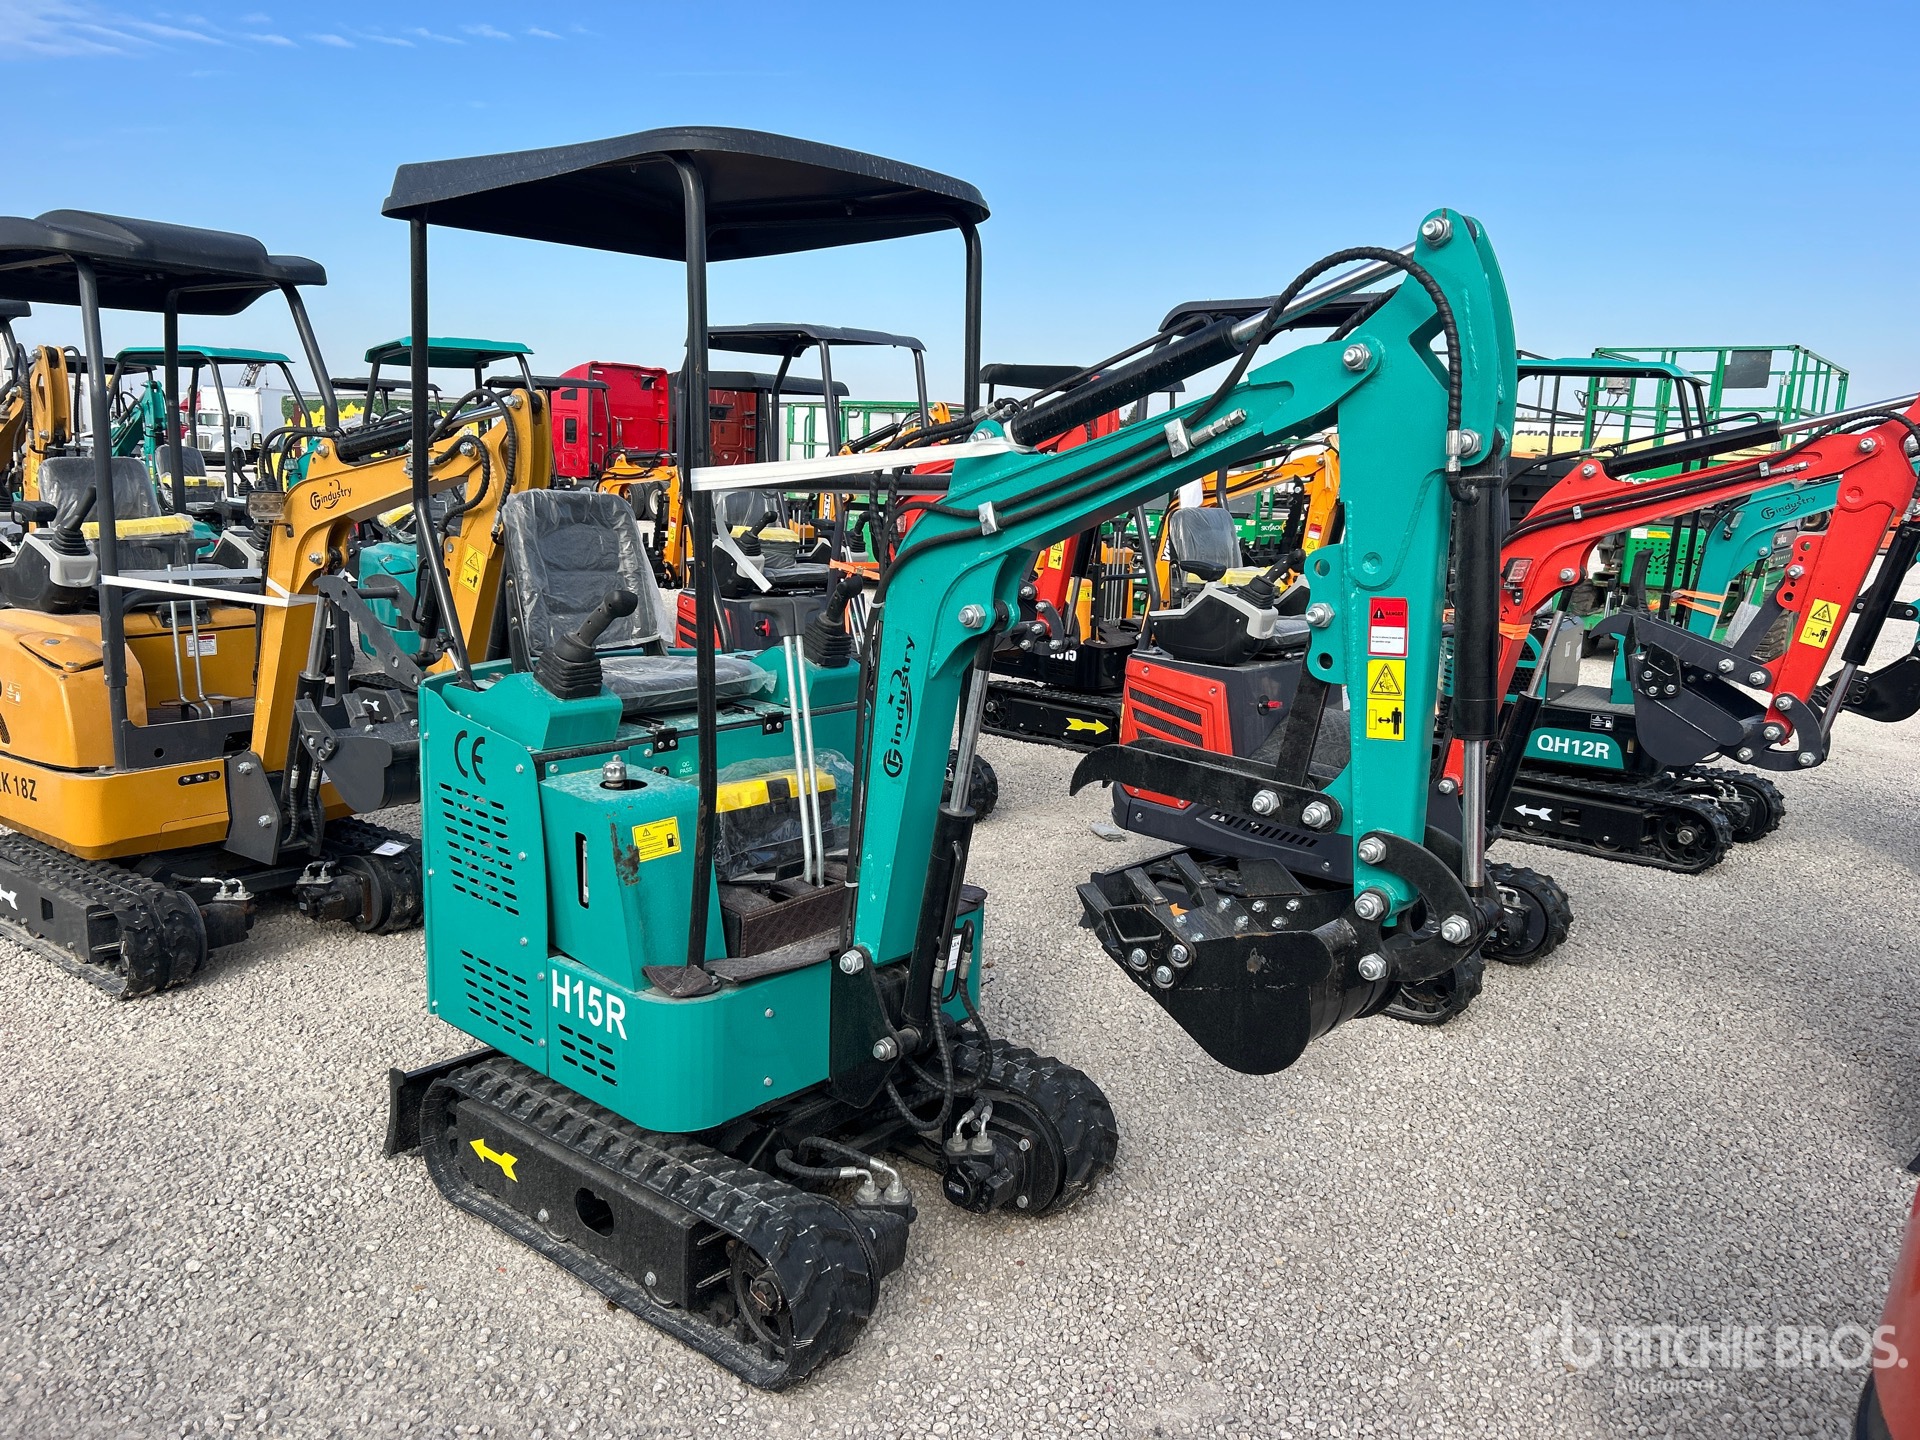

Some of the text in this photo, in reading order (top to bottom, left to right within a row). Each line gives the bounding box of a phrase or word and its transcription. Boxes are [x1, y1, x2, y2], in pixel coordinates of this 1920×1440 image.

[454, 729, 486, 786] CE
[1537, 734, 1610, 760] QH12R
[679, 766, 693, 775] PASS
[682, 760, 690, 768] QC
[0, 771, 37, 802] K 18Z
[552, 968, 628, 1041] H15R
